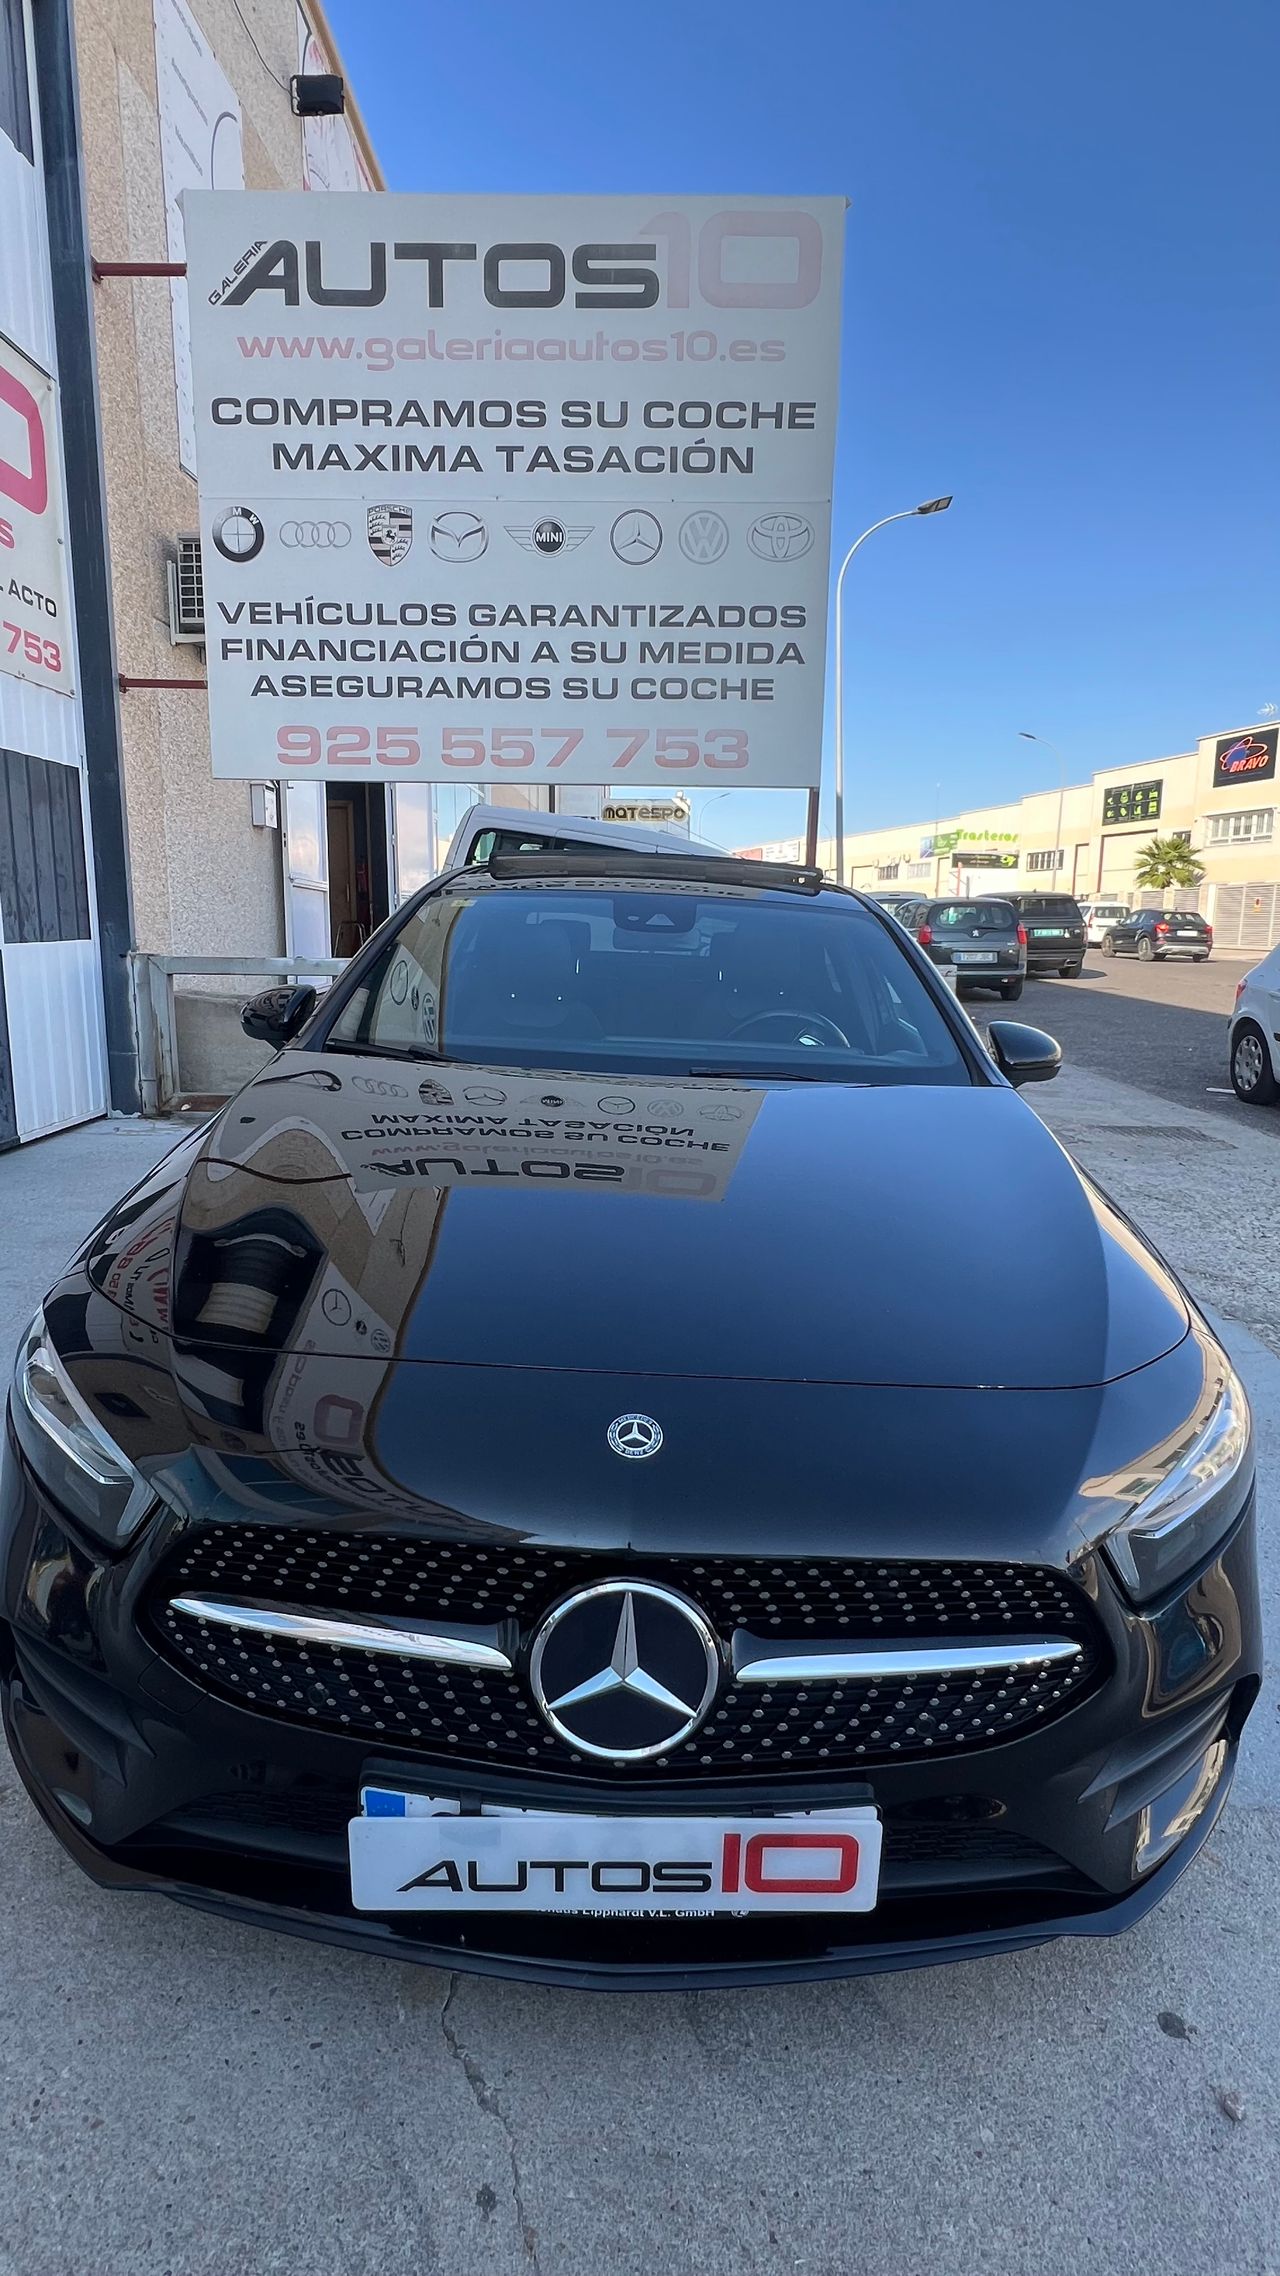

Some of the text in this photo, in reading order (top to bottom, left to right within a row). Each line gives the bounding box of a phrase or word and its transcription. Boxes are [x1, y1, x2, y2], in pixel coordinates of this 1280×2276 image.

[208, 240, 268, 306] GALERIA
[235, 330, 787, 372] www.galeriaautos10.es
[211, 397, 817, 431] COMPRAMOS SU COCHE
[272, 439, 755, 474] MAXIMA TASACIÓN
[534, 531, 564, 544] MINI
[8, 577, 58, 619] ACTO
[217, 595, 807, 629] VEHÍCULOS GARANTIZADOS
[2, 620, 63, 674] 753
[219, 634, 806, 666] FINANCIACIÓN A SU MEDIDA
[250, 674, 775, 702] ASEGURAMOS SU COCHE
[276, 724, 751, 770] 925 557 753
[1229, 755, 1269, 773] BRAVO
[956, 828, 1019, 842] Trasteros
